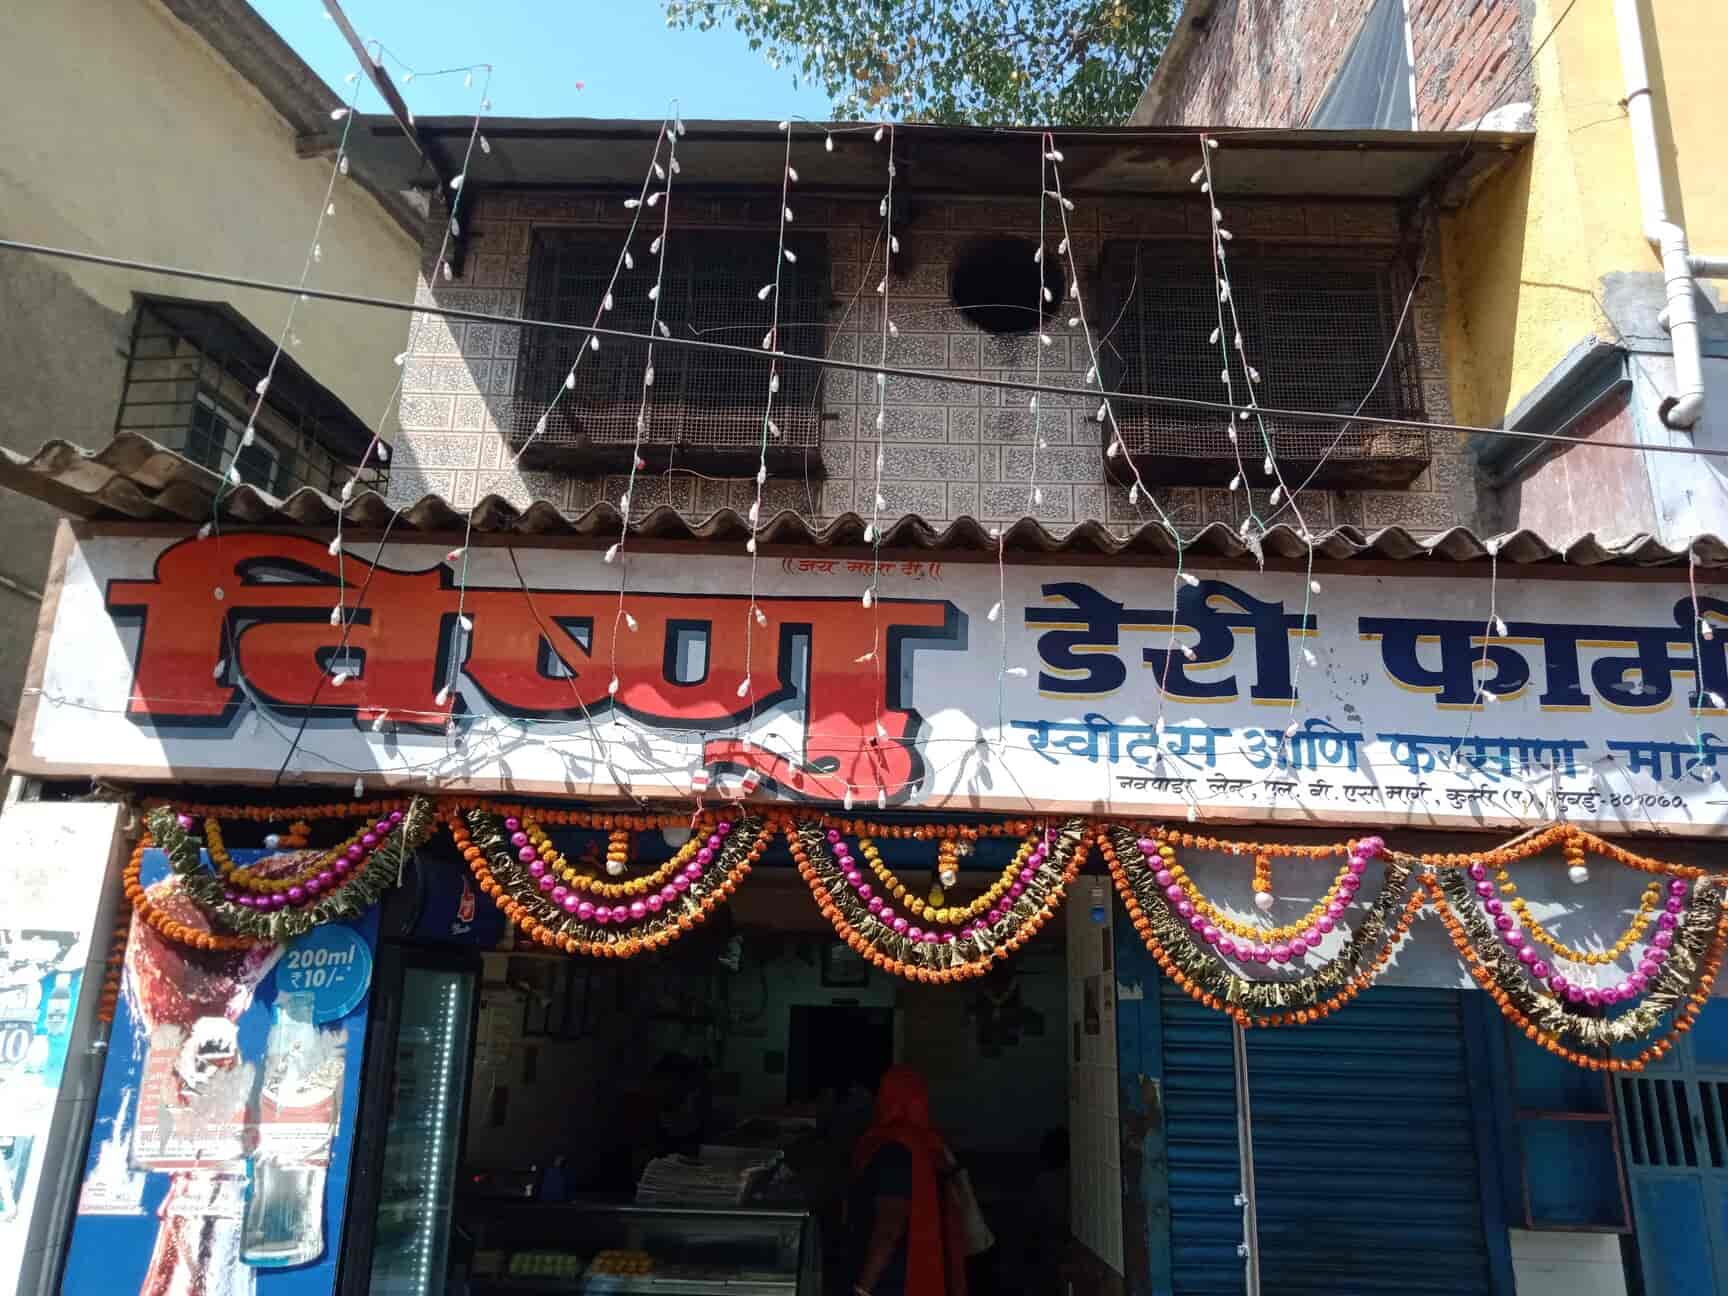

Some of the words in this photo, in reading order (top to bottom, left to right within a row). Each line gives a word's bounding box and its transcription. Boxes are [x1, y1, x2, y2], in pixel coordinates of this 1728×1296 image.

[1024, 580, 1320, 707] डेरी
[1240, 718, 1364, 772] आणि
[287, 943, 356, 969] 200ml
